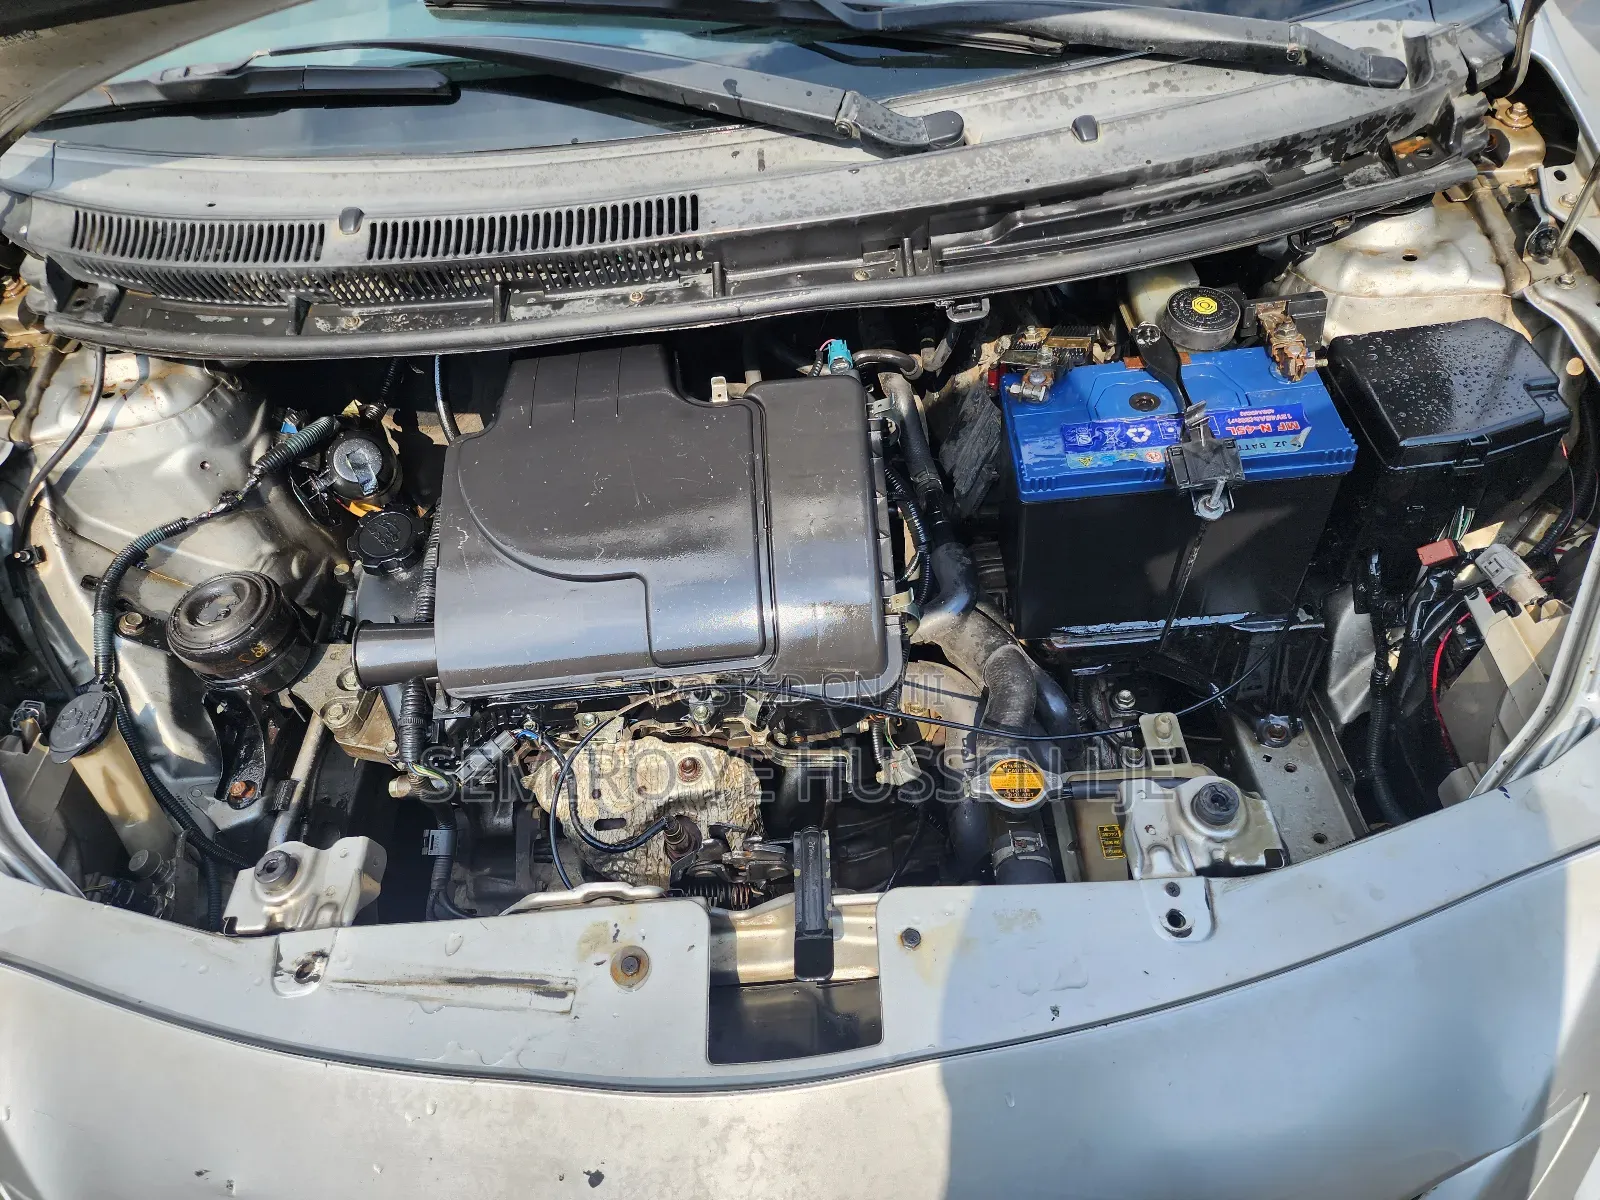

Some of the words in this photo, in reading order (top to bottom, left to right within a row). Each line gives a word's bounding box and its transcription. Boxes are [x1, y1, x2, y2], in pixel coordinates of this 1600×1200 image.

[1225, 422, 1273, 436] N-45L
[1277, 420, 1301, 432] MF
[1273, 440, 1287, 448] JZ
